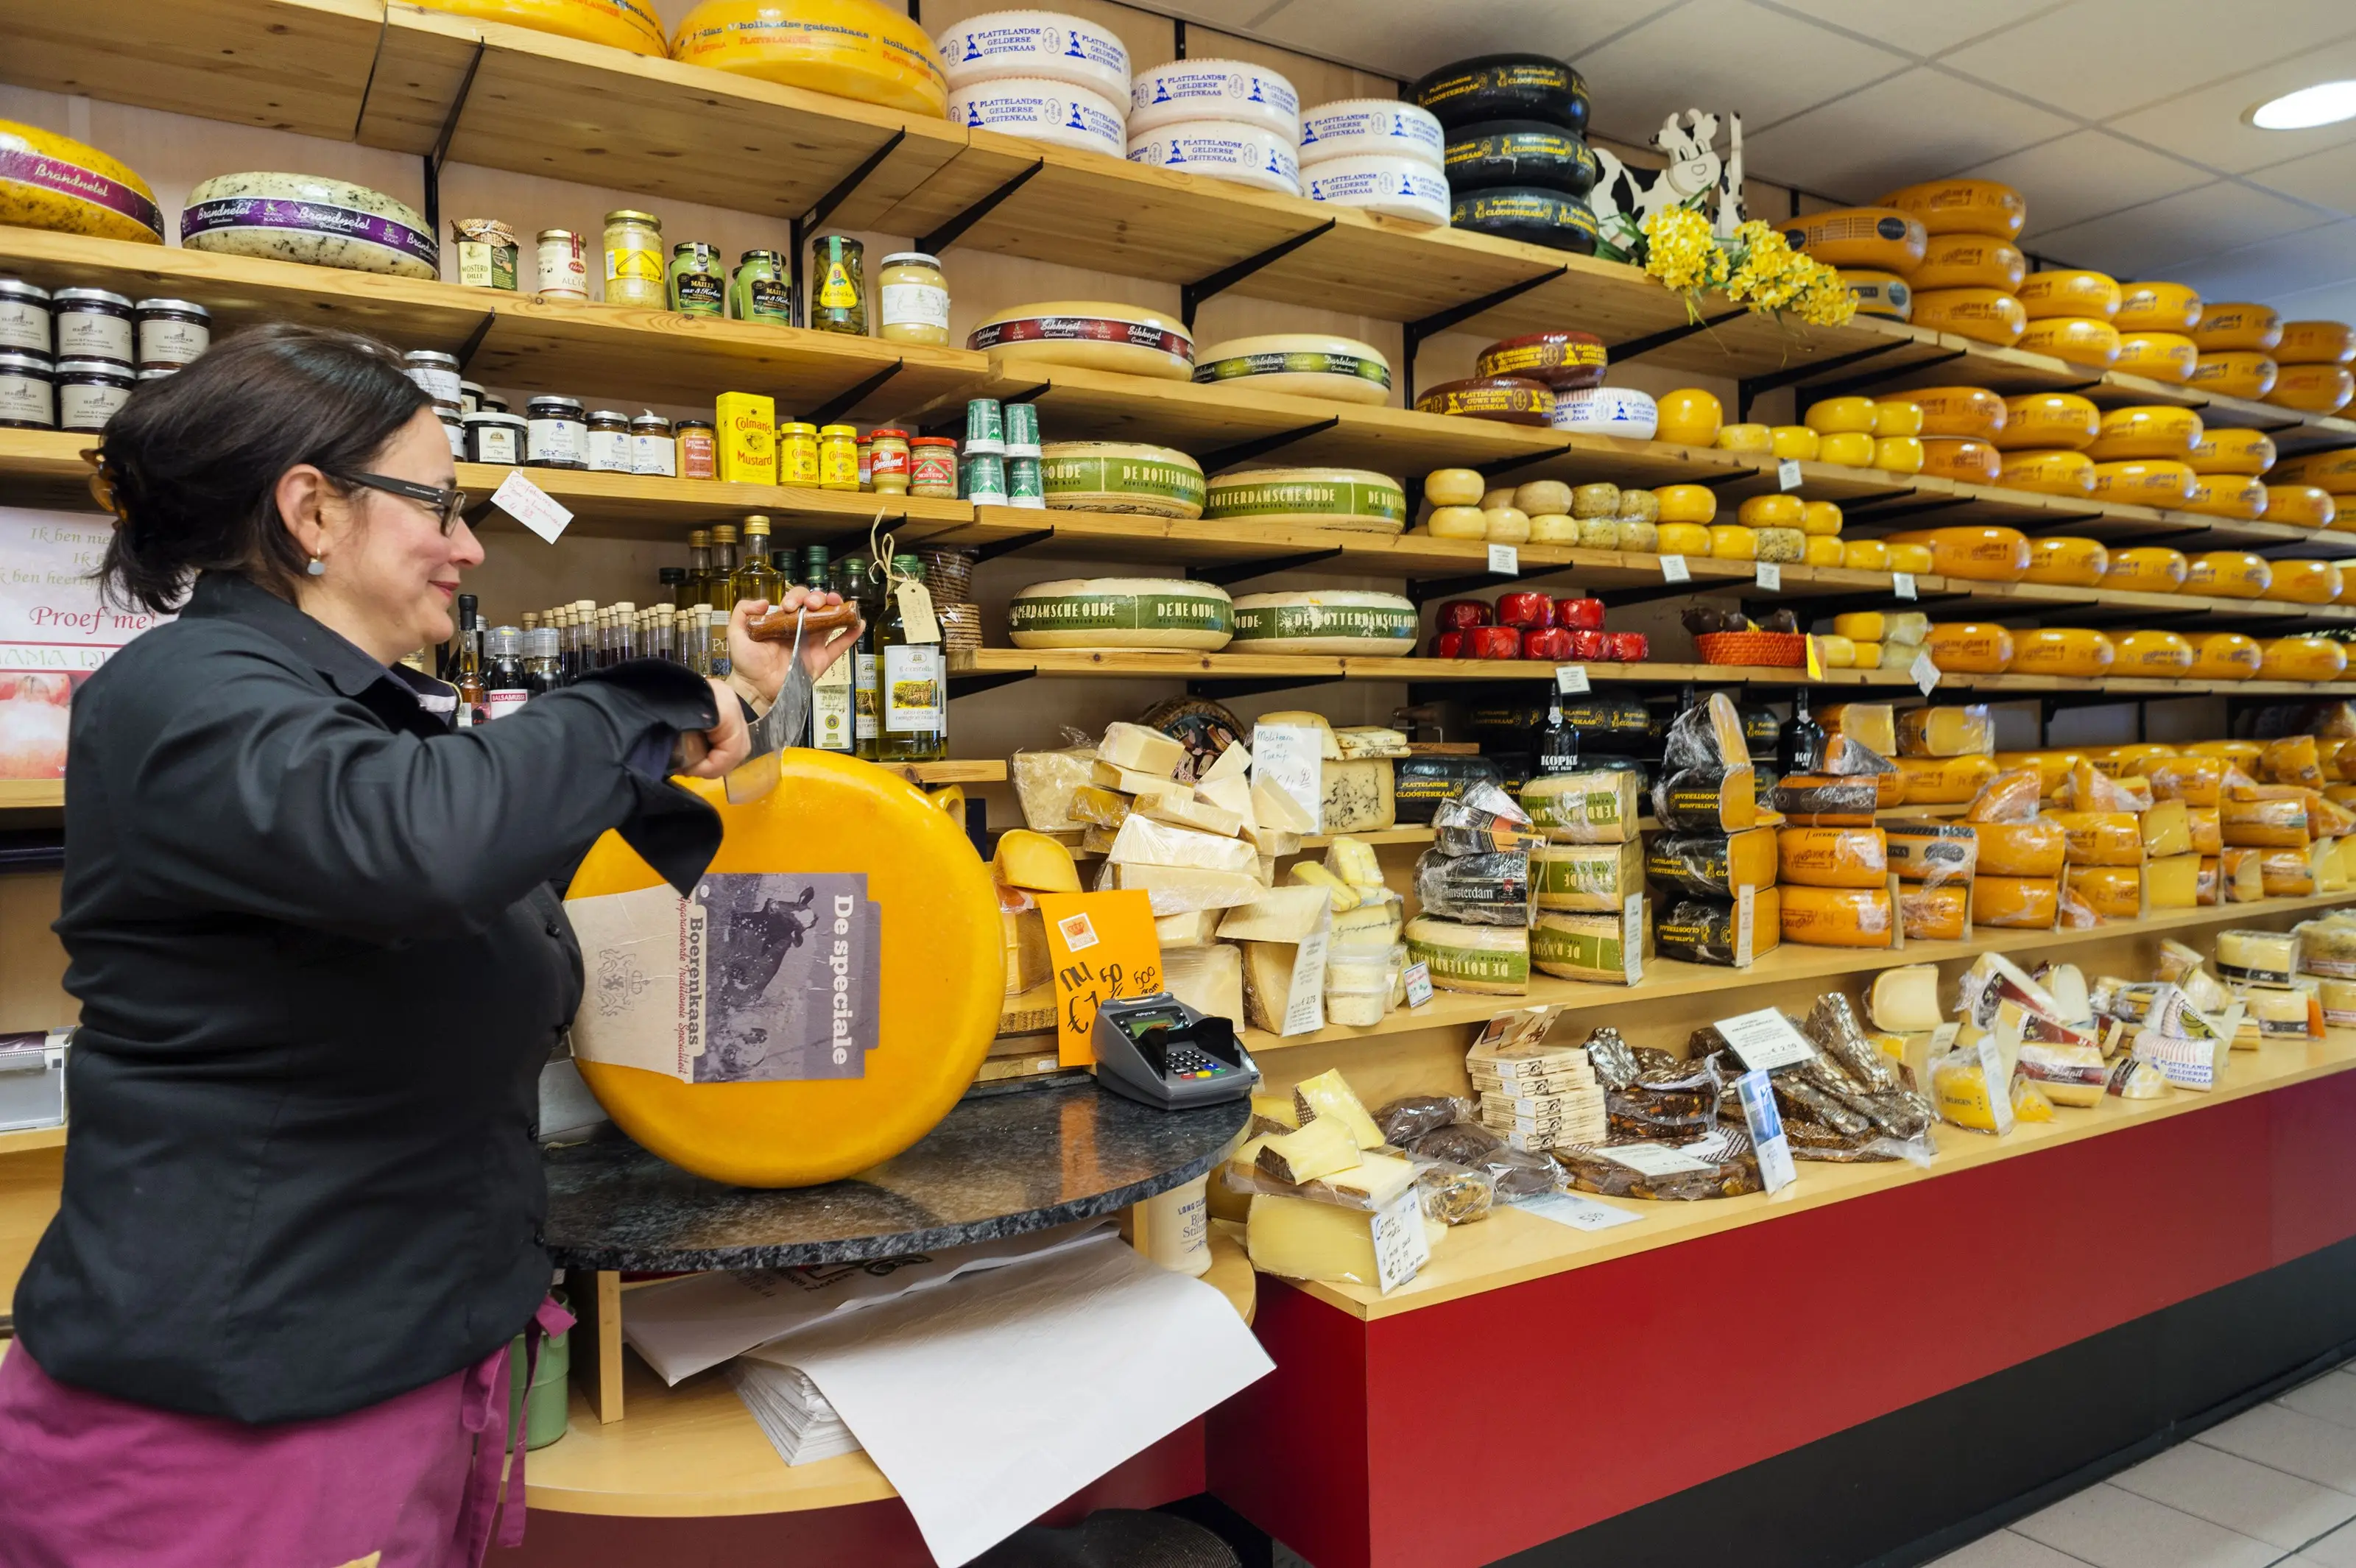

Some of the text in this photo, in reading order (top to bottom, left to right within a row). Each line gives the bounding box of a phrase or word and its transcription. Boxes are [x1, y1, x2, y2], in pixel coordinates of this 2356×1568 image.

[978, 28, 1041, 40] PLATTELANDSE
[987, 37, 1031, 46] GELDERSE
[984, 45, 1036, 55] GEITENKAAS
[1168, 74, 1227, 84] PLATTELANDSE
[1429, 76, 1472, 93] PLATTELANDSE
[1508, 77, 1561, 87] CLOOSTERKAAS
[1177, 82, 1218, 90] GELDERSE
[1173, 90, 1222, 98] GEITENKAAS
[1425, 82, 1479, 105] CLOOSTERKAAS
[980, 98, 1043, 107] PLATTELANDSE
[989, 107, 1034, 115] GELDERSE
[985, 114, 1037, 123] GEITENKAAS
[1314, 113, 1370, 127] PLATTELANDSE
[1322, 121, 1361, 131] GELDERSE
[1319, 128, 1366, 140] GEITENKAAS
[1182, 139, 1243, 149] PLATTELANDSE
[1191, 146, 1234, 155] GELDERSE
[1512, 145, 1567, 156] CLOOSTERKAAS
[1188, 155, 1238, 163] GEITENKAAS
[35, 164, 108, 197] Brandnetel
[1322, 173, 1378, 186] PLATTELANDSE
[1330, 181, 1369, 190] GELDERSE
[1327, 188, 1373, 199] GEITENKAAS
[197, 202, 252, 222] Brandnetel
[297, 206, 371, 230] Brandnetel
[1485, 208, 1545, 218] CLOOSTERKAAS
[462, 264, 488, 272] MOSTERD
[691, 279, 714, 289] MAILLE
[765, 286, 787, 297] MAILLE
[1040, 319, 1082, 332] Sikkepit
[976, 325, 1001, 341] Sikkepit
[1126, 325, 1163, 342] Sikkepit
[1459, 390, 1513, 399] PLATTELANDSE
[736, 417, 772, 435] Colman's
[737, 450, 772, 465] Mustard
[828, 451, 855, 463] Colman's
[829, 473, 855, 481] Mustard
[1048, 465, 1081, 478] OUDE
[1123, 465, 1138, 479] DE
[1210, 488, 1336, 506] ROTTERDAMSCHE OUDE
[1368, 490, 1379, 504] DE
[55, 529, 81, 544] ben
[88, 532, 110, 545] nie
[13, 569, 40, 584] ben
[1082, 603, 1116, 616] OUDE
[1191, 604, 1215, 618] OUDE
[29, 606, 157, 635] Proef me!
[1235, 615, 1260, 629] OUDE
[1295, 614, 1310, 626] DE
[1540, 755, 1579, 766] KOPKE
[1492, 963, 1509, 977] DE
[688, 917, 705, 1046] Boerenkaas
[829, 894, 855, 1065] De speciale
[1099, 963, 1123, 993] 50
[1134, 966, 1156, 989] 500
[677, 964, 691, 1019] Traditionele
[674, 1022, 691, 1076] Specialiteit
[2168, 1067, 2209, 1077] GELDERSE
[1177, 1202, 1194, 1215] LONG
